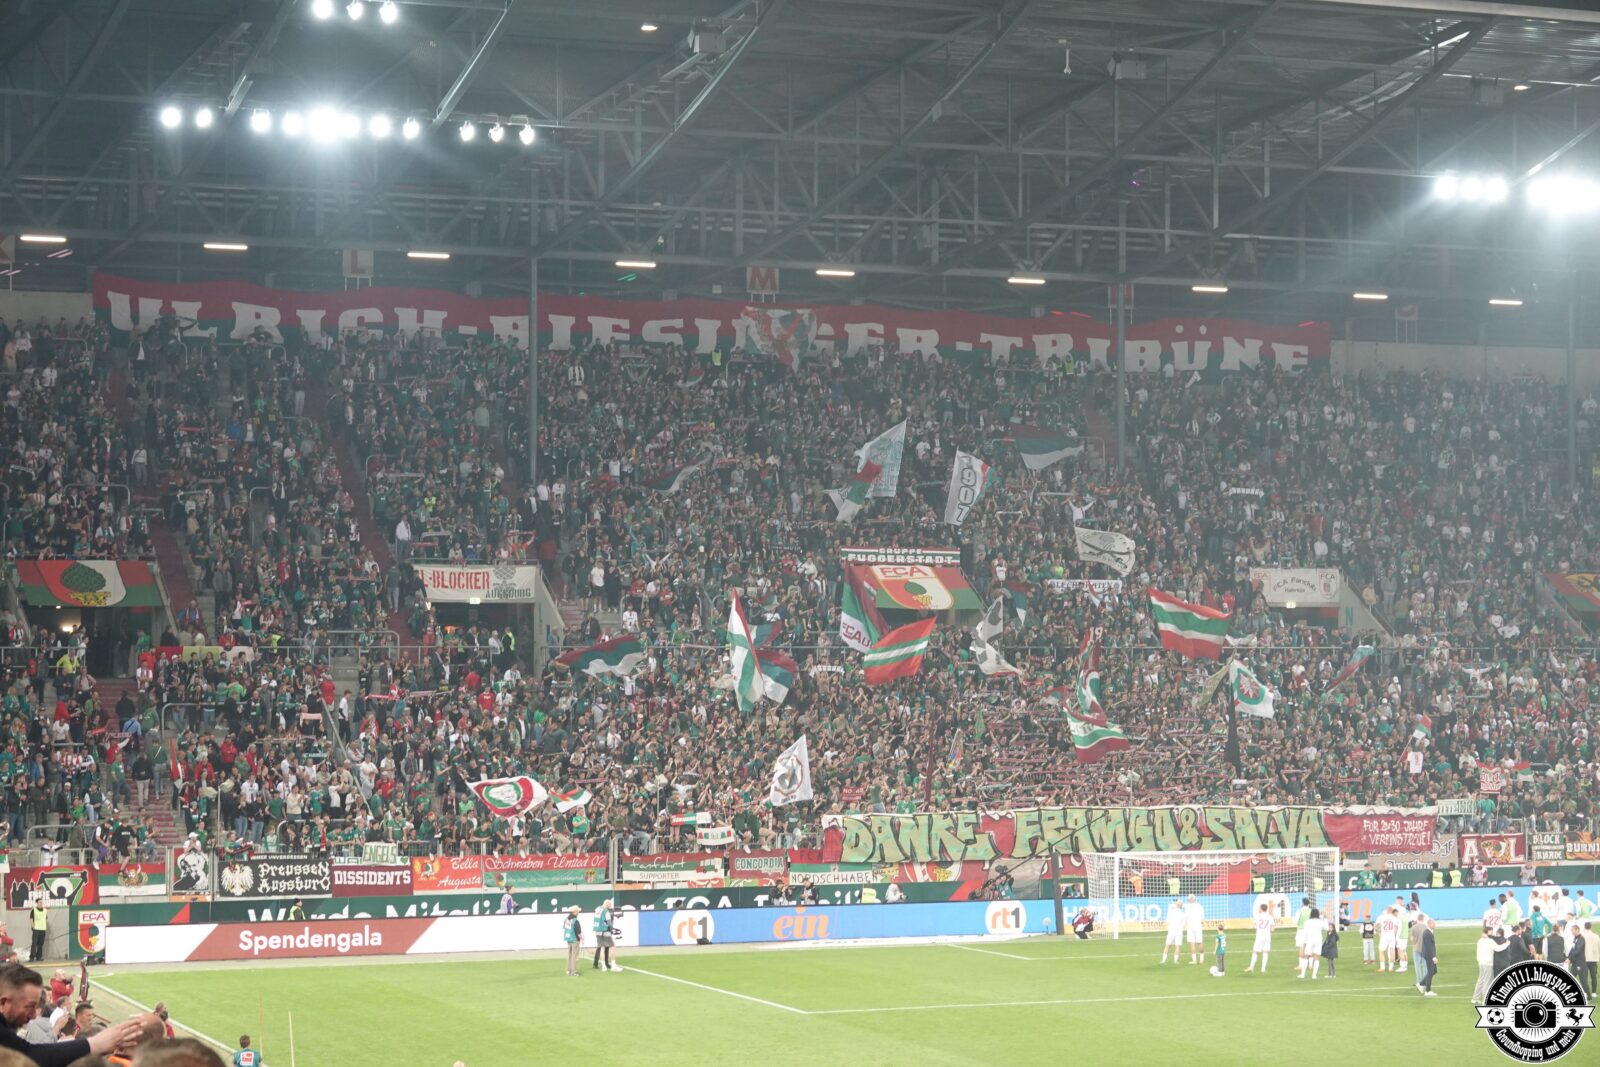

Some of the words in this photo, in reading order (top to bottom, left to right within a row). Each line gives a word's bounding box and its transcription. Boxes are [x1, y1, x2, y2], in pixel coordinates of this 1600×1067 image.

[748, 267, 779, 292] M
[879, 547, 923, 555] GRUPPE
[847, 553, 954, 564] FUGGERSTADT
[880, 565, 929, 578] FCA
[1179, 806, 1202, 847] &
[842, 813, 1001, 863] DANKE
[451, 857, 479, 871] Bella
[484, 856, 545, 870] Schwaben
[735, 856, 785, 870] CONCORDIA
[333, 869, 412, 886] DISSIDENTS
[437, 875, 482, 889] Augusta
[639, 872, 680, 880] SUPPORTER
[82, 912, 107, 922] FCA
[772, 906, 829, 940] ein
[991, 907, 1021, 930] rt1
[676, 916, 709, 940] rt1
[238, 924, 383, 955] Spendengala
